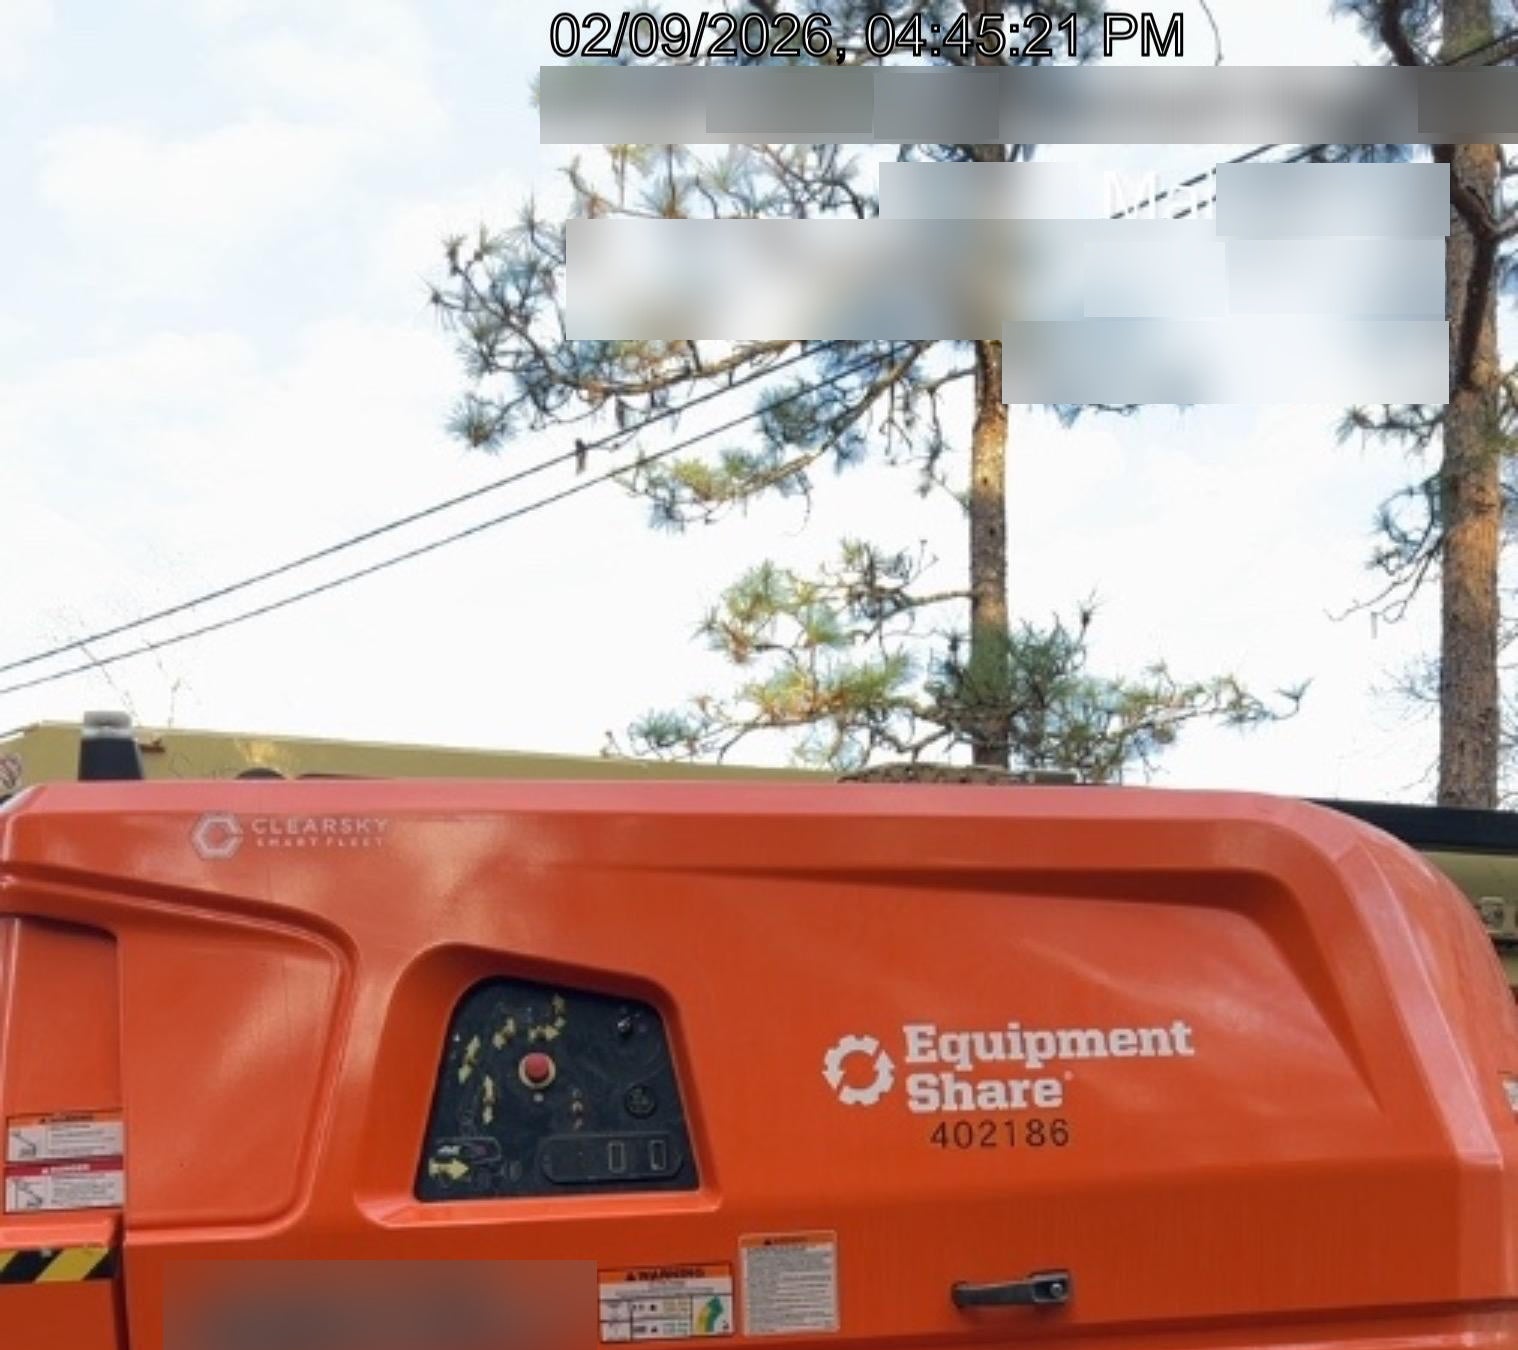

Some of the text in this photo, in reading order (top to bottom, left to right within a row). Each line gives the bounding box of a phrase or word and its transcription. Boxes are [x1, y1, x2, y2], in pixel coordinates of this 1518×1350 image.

[251, 817, 388, 835] CLEARSKY
[903, 1020, 1195, 1072] Equipment
[905, 1073, 1064, 1114] Share
[930, 1118, 1070, 1149] 402186
